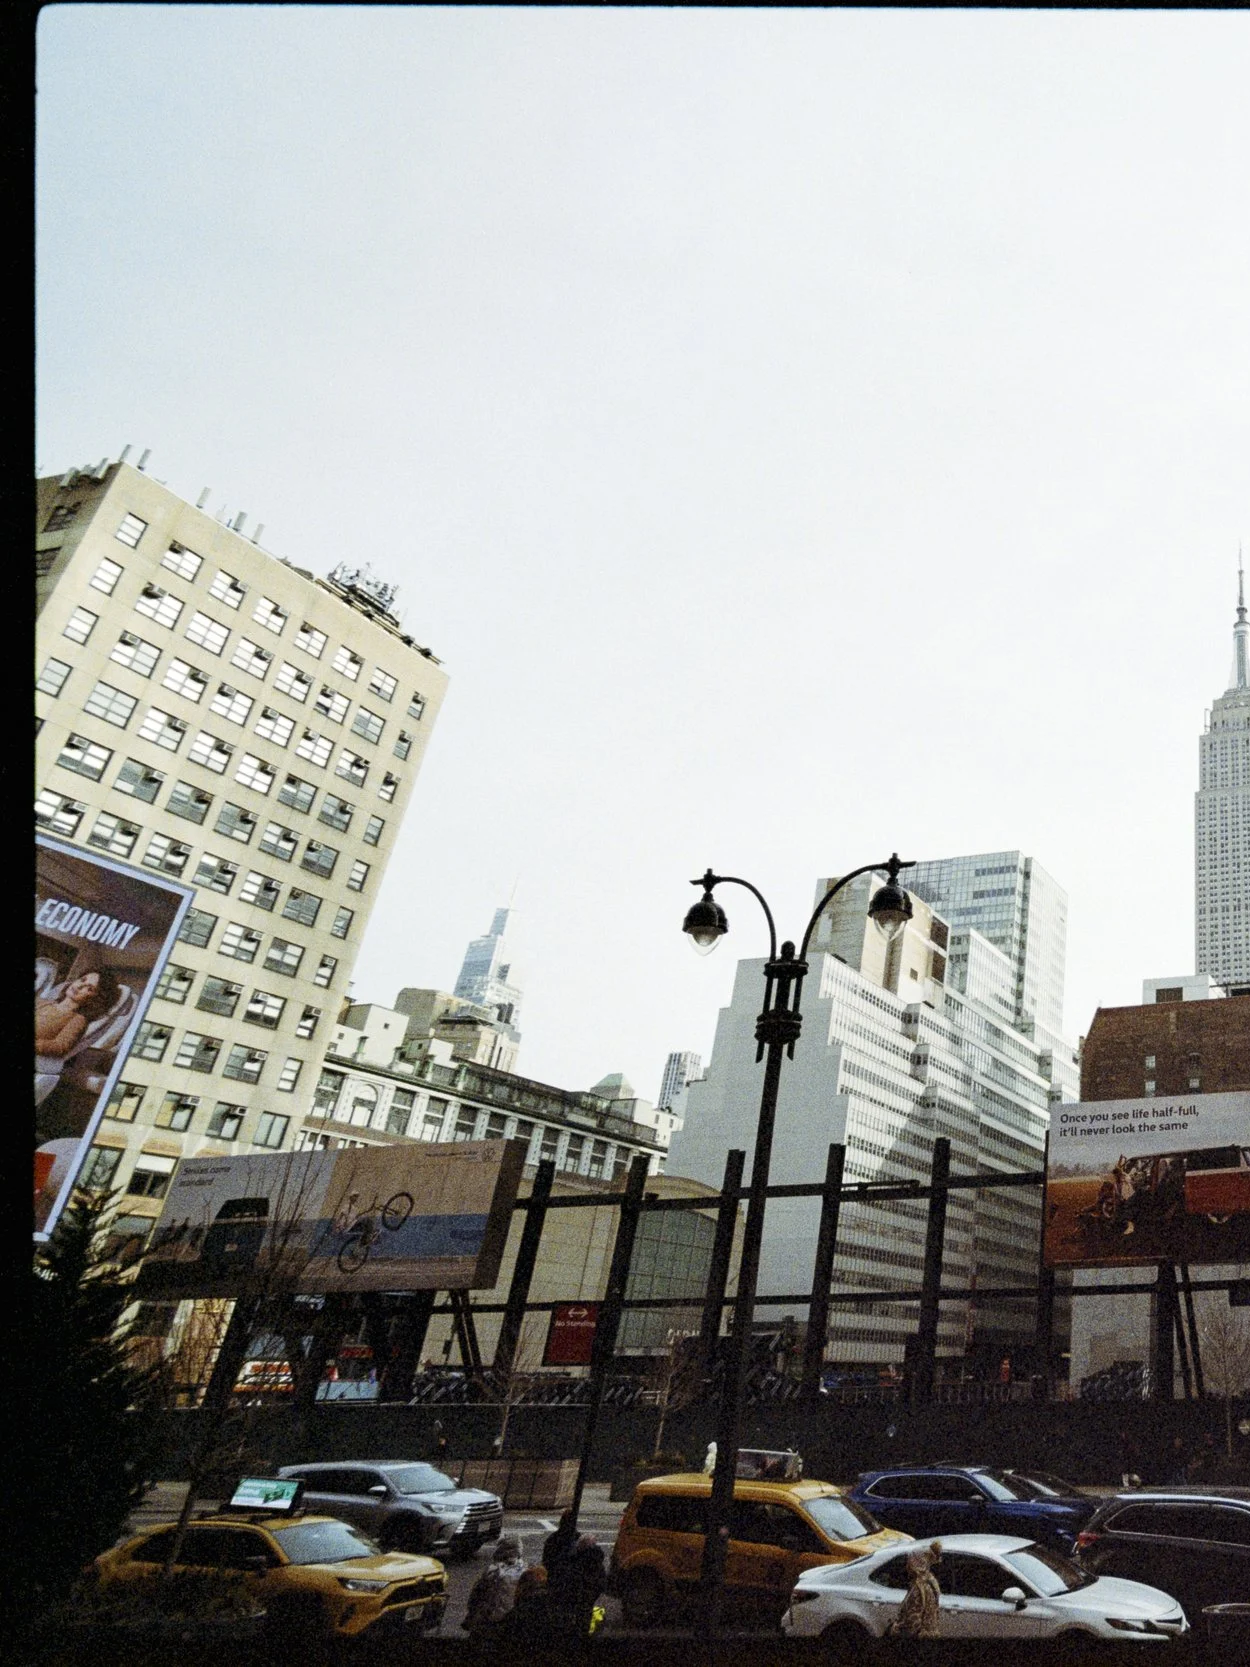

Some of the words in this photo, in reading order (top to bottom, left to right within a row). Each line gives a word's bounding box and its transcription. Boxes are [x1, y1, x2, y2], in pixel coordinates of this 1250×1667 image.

[35, 898, 141, 950] ECONOMY
[1060, 1113, 1087, 1124] Once
[1089, 1112, 1109, 1125] you
[1111, 1110, 1129, 1121] see
[1132, 1108, 1149, 1119] life
[1152, 1105, 1199, 1118] half-full,
[1059, 1126, 1077, 1137] it'll
[1080, 1125, 1109, 1136] never
[1112, 1122, 1135, 1135] look
[1138, 1121, 1156, 1132] the
[1159, 1121, 1188, 1132] same
[566, 1320, 596, 1329] Standing
